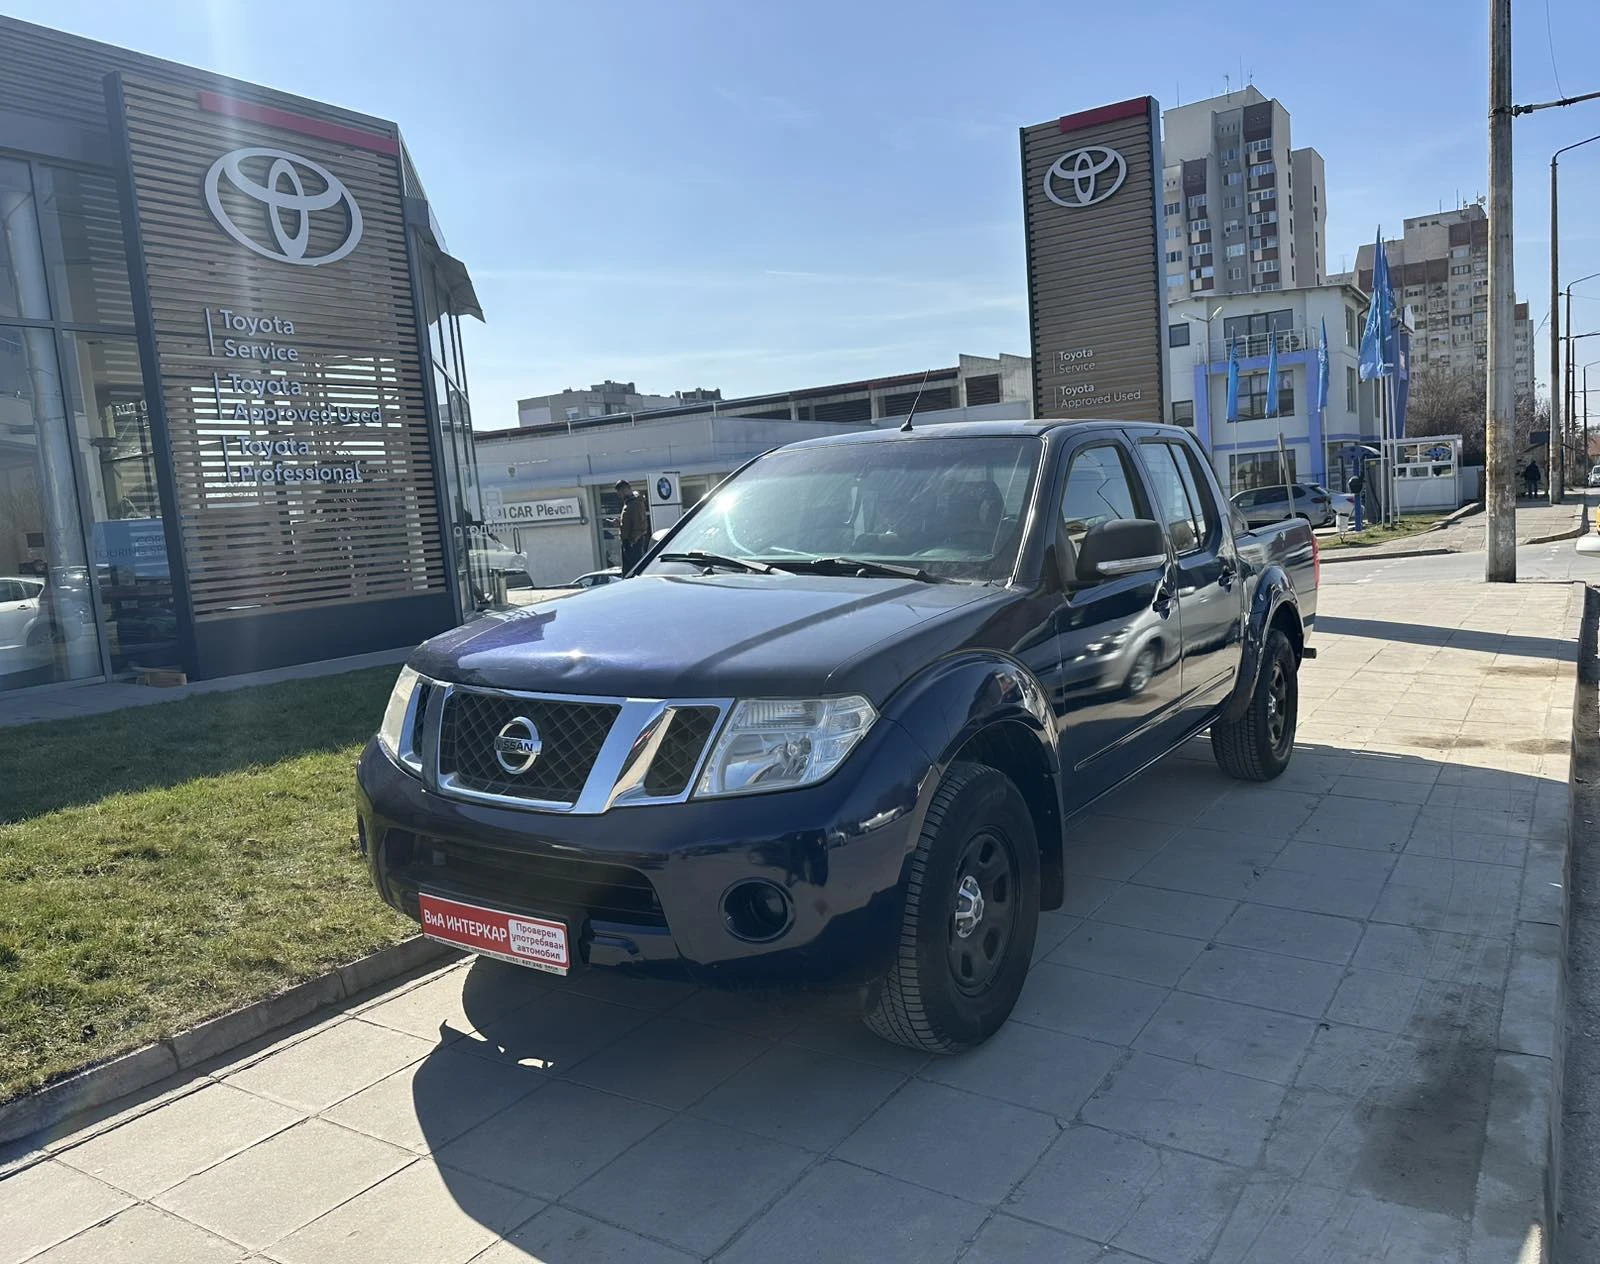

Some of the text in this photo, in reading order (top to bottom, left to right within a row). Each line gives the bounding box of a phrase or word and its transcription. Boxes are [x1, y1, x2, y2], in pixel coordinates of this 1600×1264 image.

[219, 309, 295, 337] Toyota
[224, 339, 299, 362] Service
[1059, 349, 1094, 361] Toyota
[1059, 362, 1096, 374] Service
[227, 373, 302, 398] Toyota
[1060, 383, 1095, 397] Toyota
[1060, 389, 1141, 409] Approved Used
[233, 402, 383, 425] Approved Used
[236, 436, 310, 460] Toyota
[239, 459, 362, 483] Professional
[508, 505, 534, 519] CAR
[536, 503, 574, 517] Pleven
[423, 909, 446, 927] ВиА
[446, 914, 508, 943] ИНТЕРКАР
[516, 922, 557, 940] Проверен
[511, 933, 564, 951] употребяван
[516, 945, 561, 960] автомобил
